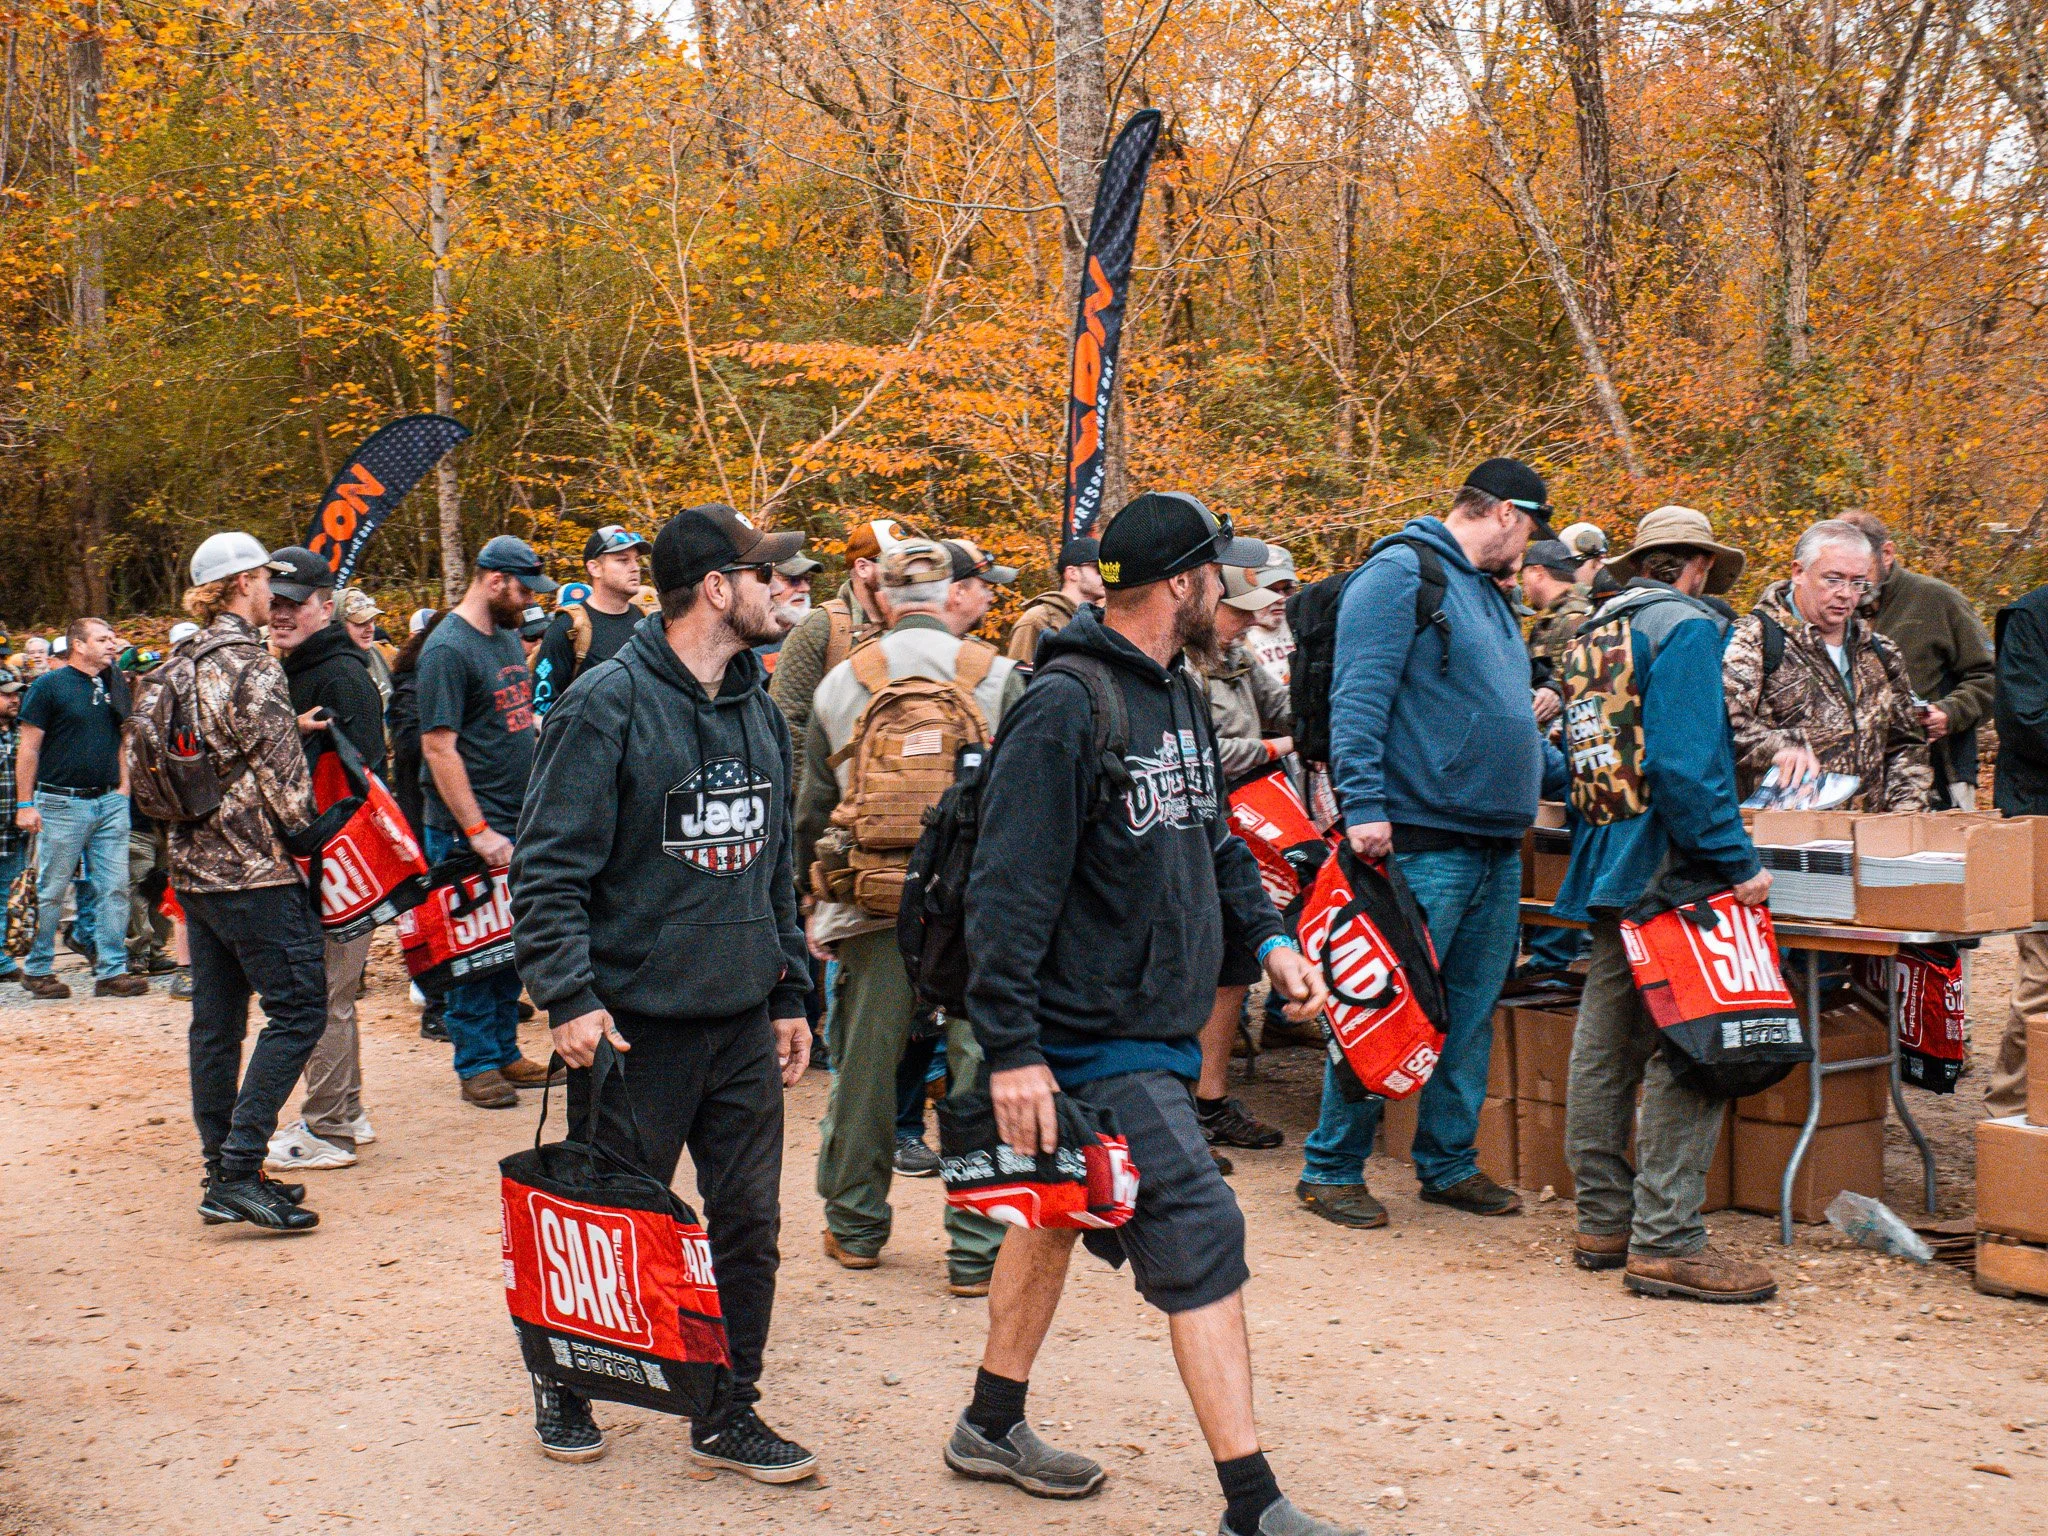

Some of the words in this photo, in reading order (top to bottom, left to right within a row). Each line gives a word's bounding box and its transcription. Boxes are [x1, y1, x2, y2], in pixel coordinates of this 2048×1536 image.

[1073, 460, 1106, 540] PRESSE
[681, 792, 765, 838] Jeep
[1698, 904, 1787, 993] SAR
[541, 1207, 631, 1334] SAR
[682, 1238, 718, 1286] AR
[570, 1342, 638, 1366] sarusa.com
